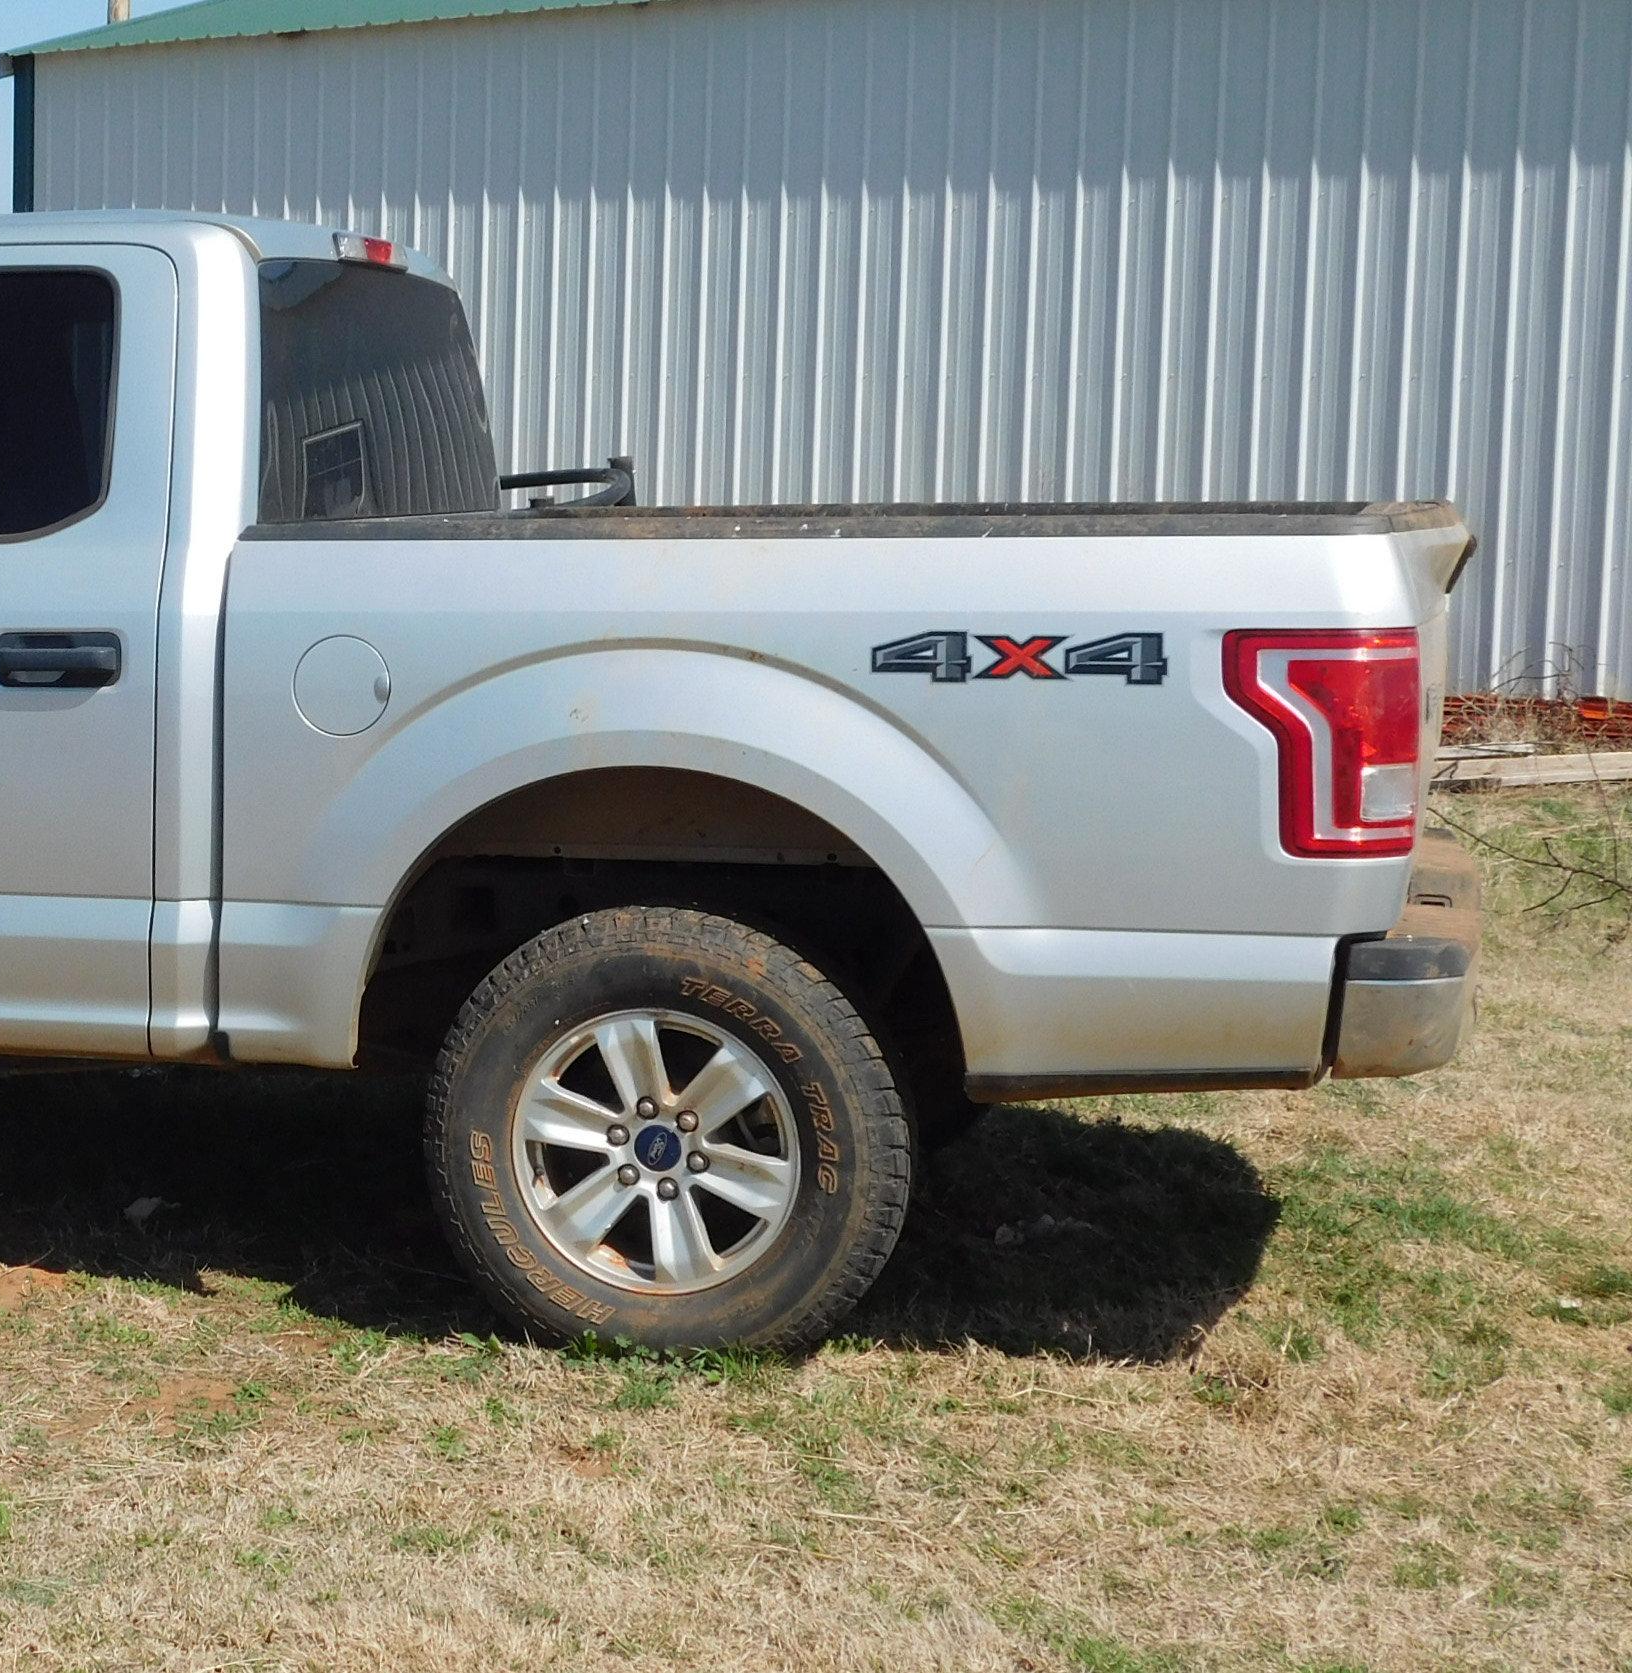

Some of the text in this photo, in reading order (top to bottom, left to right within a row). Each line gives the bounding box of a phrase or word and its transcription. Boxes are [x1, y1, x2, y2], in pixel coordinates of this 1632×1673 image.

[680, 975, 840, 1195] TERRA TRAC
[470, 1130, 616, 1326] HERCULES
